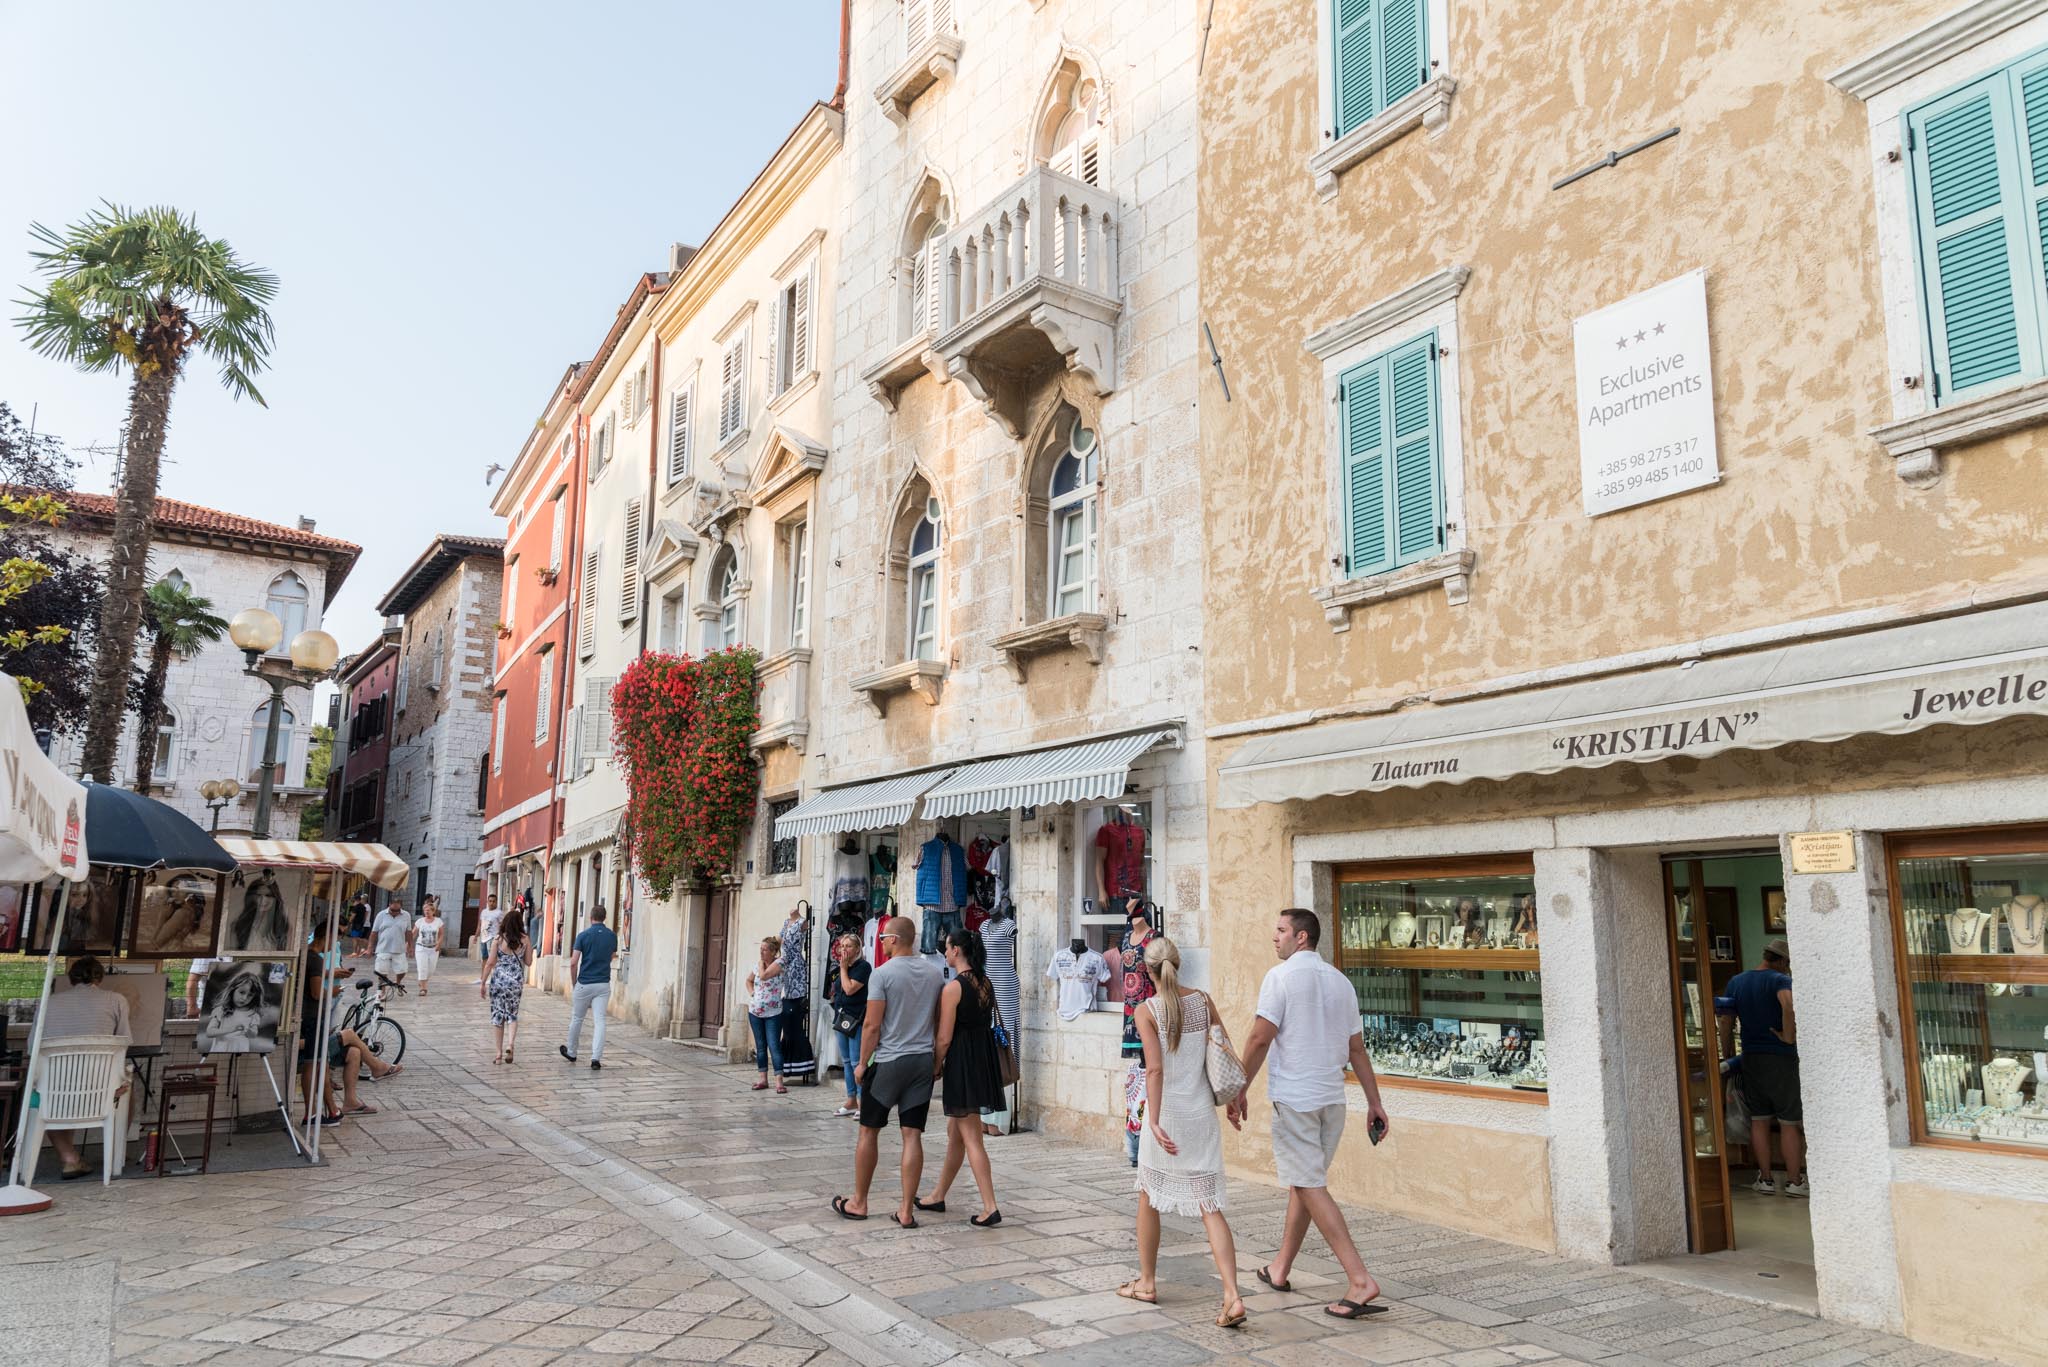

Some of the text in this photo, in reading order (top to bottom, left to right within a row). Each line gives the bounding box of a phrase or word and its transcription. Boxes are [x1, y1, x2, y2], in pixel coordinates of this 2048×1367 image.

[1599, 353, 1685, 396] Exclusive
[1588, 374, 1702, 427] Apartments
[1594, 457, 1703, 499] +385 99 485 1400
[1598, 437, 1698, 478] +385 98 275 317
[1903, 674, 2048, 720] Jewelle
[1552, 711, 1760, 761] “KRISTIJAN”
[1371, 757, 1460, 782] Zlatarna
